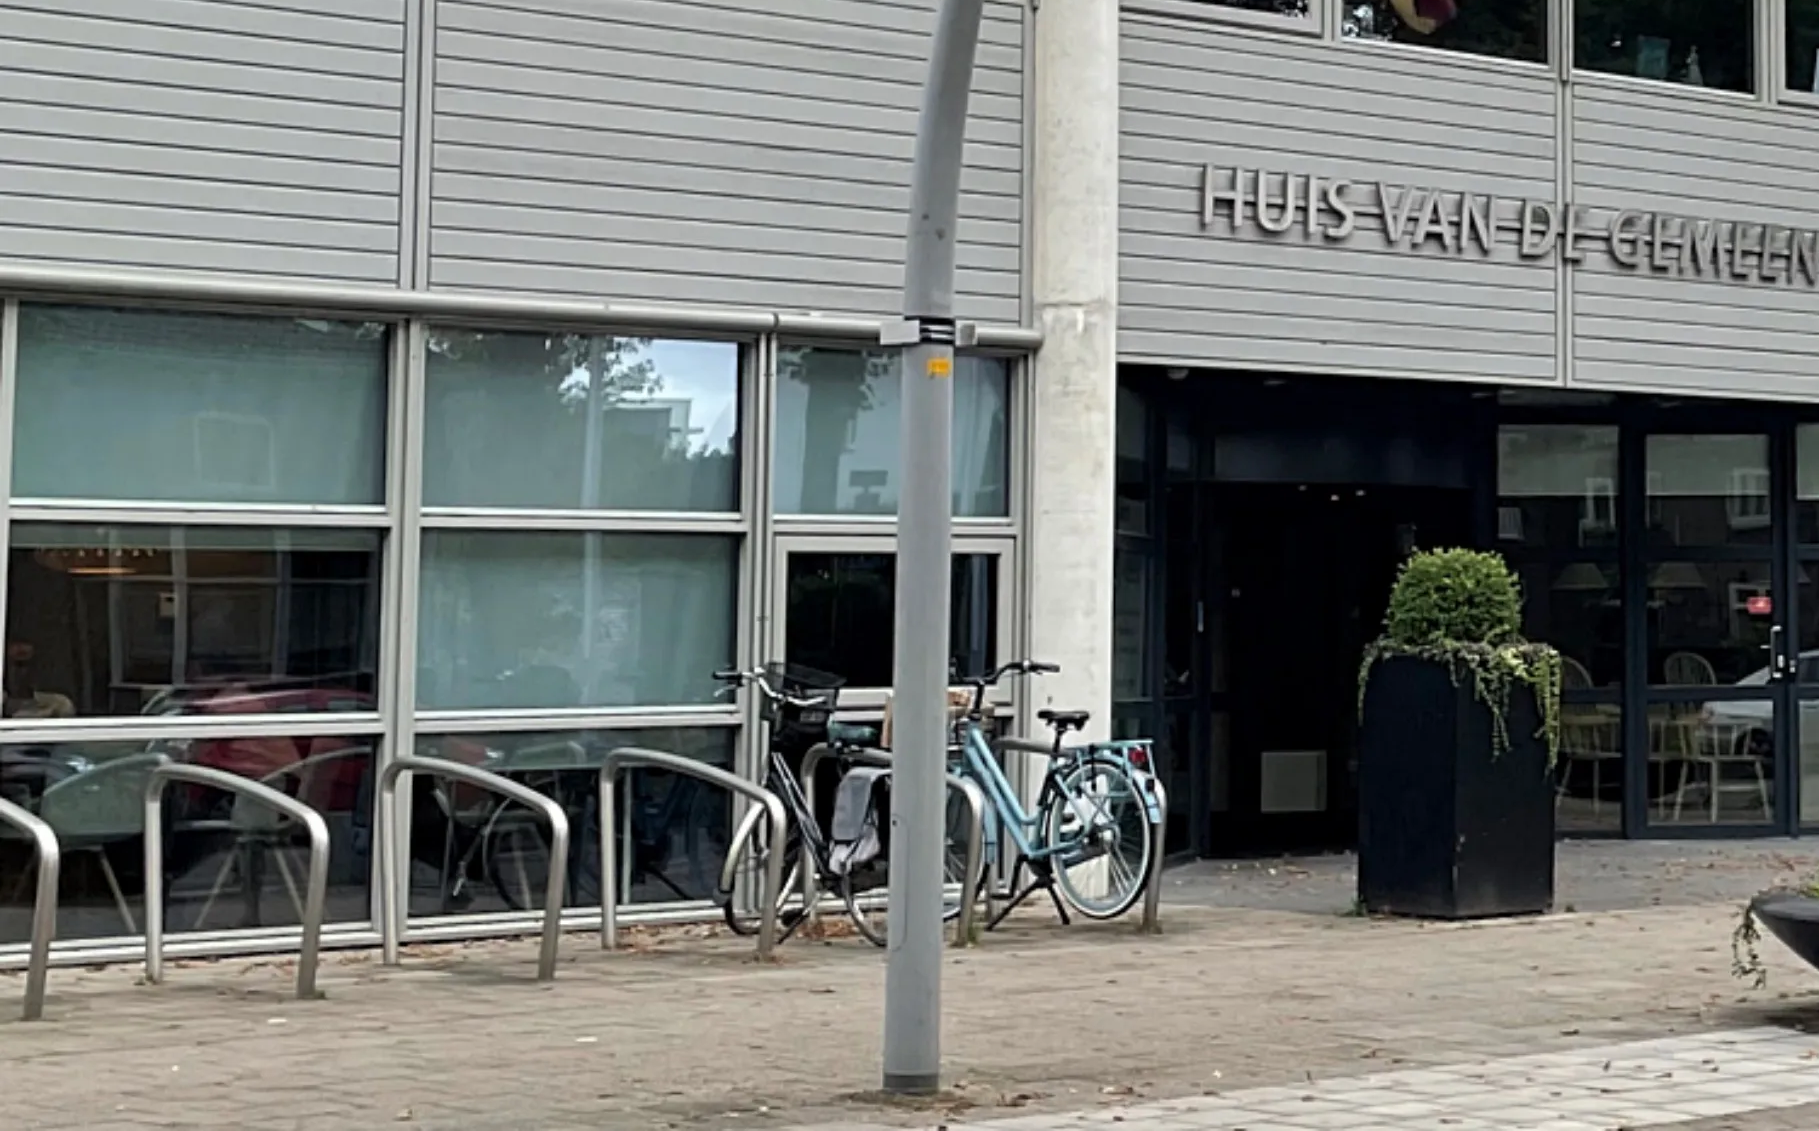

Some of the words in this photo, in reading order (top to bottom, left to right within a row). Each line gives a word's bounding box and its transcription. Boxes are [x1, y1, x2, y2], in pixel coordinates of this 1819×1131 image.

[1200, 163, 1355, 242] HUIS
[1376, 181, 1496, 255] VAN
[1520, 198, 1584, 265] DE
